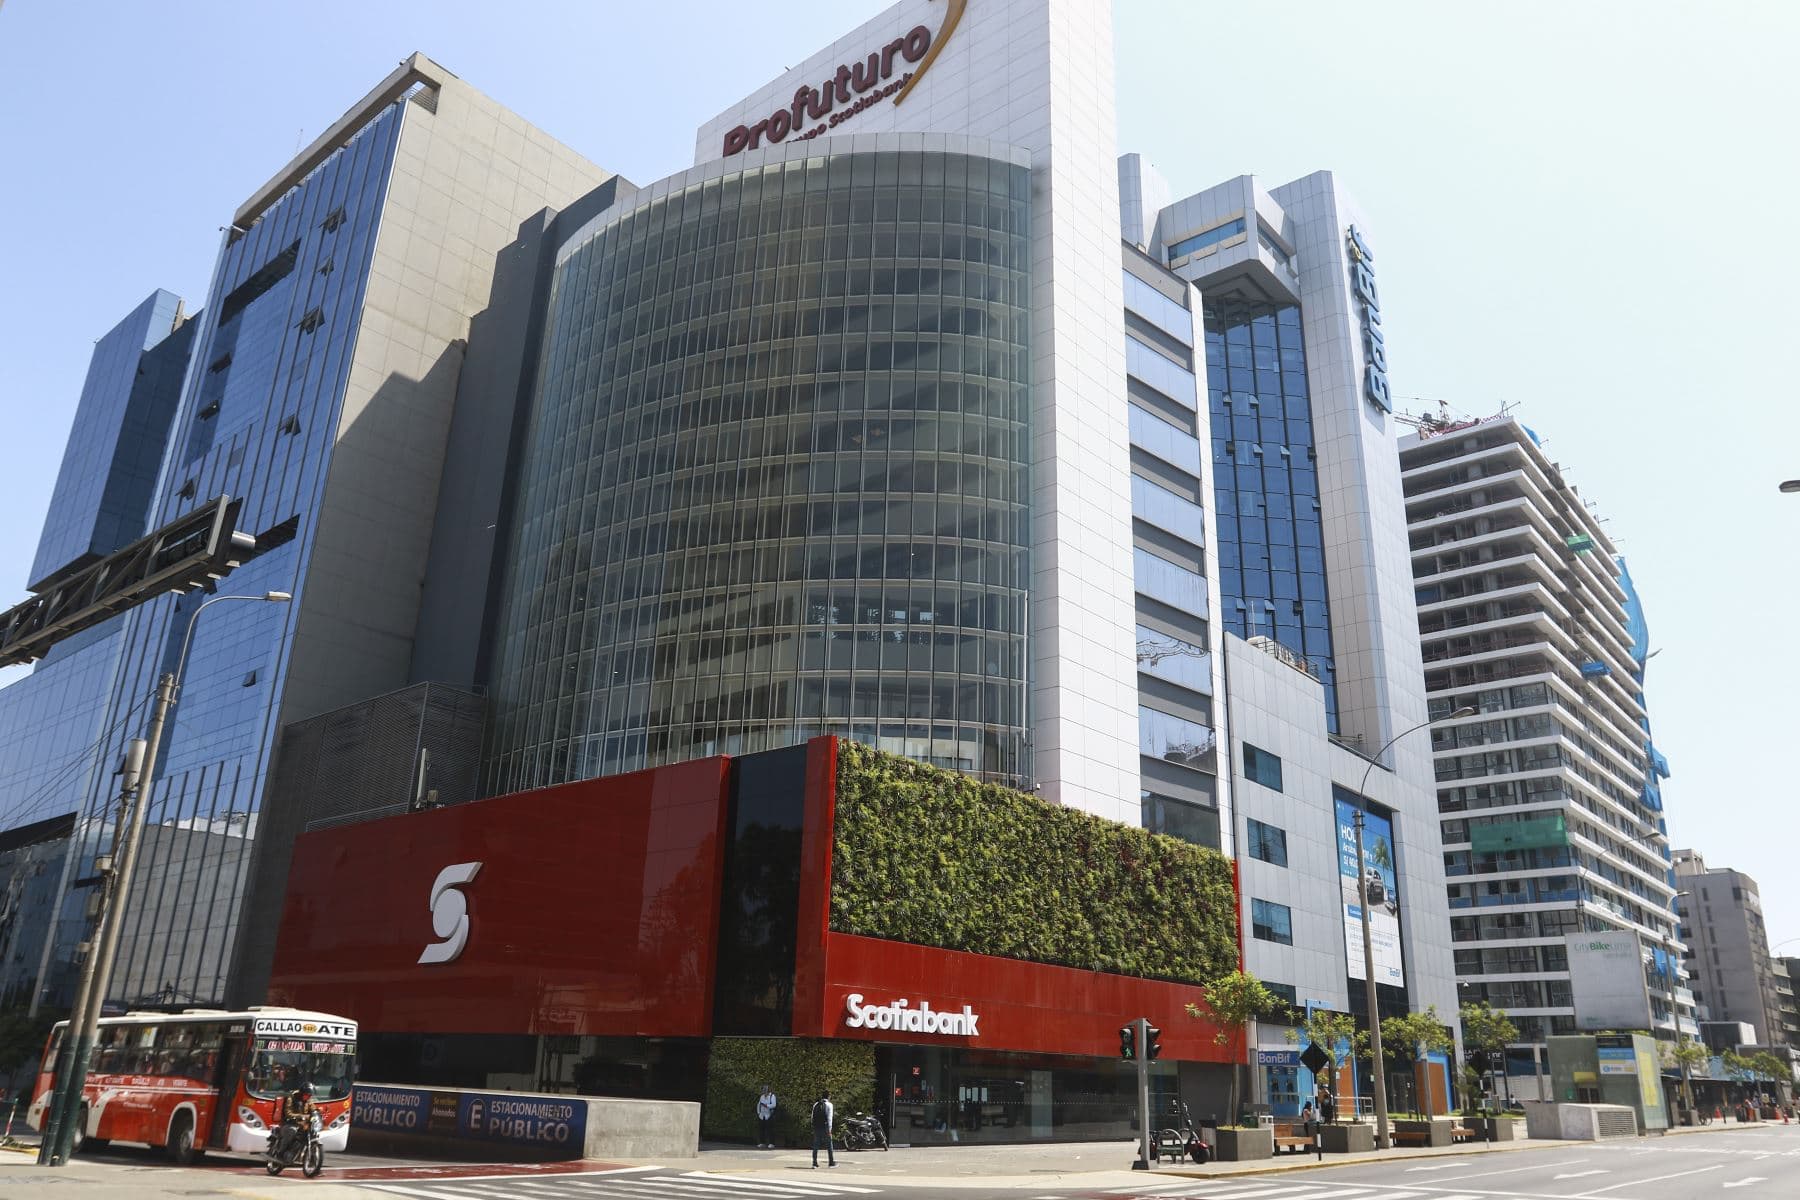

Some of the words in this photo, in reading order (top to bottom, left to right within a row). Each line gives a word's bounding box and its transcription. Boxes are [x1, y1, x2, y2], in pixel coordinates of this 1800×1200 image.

[723, 25, 931, 157] Profuturo
[1349, 224, 1393, 415] BanBif
[846, 993, 979, 1036] Scotiabank
[257, 1021, 302, 1033] CALLAO
[317, 1025, 355, 1037] ATE
[1258, 1052, 1290, 1063] BanBif
[356, 1091, 420, 1107] ESTACIONAMIENTO
[491, 1100, 573, 1119] ESTACIONAMIENTO
[353, 1104, 417, 1128] PÚBLICO
[471, 1104, 483, 1129] E
[489, 1116, 569, 1143] PÚBLICO
